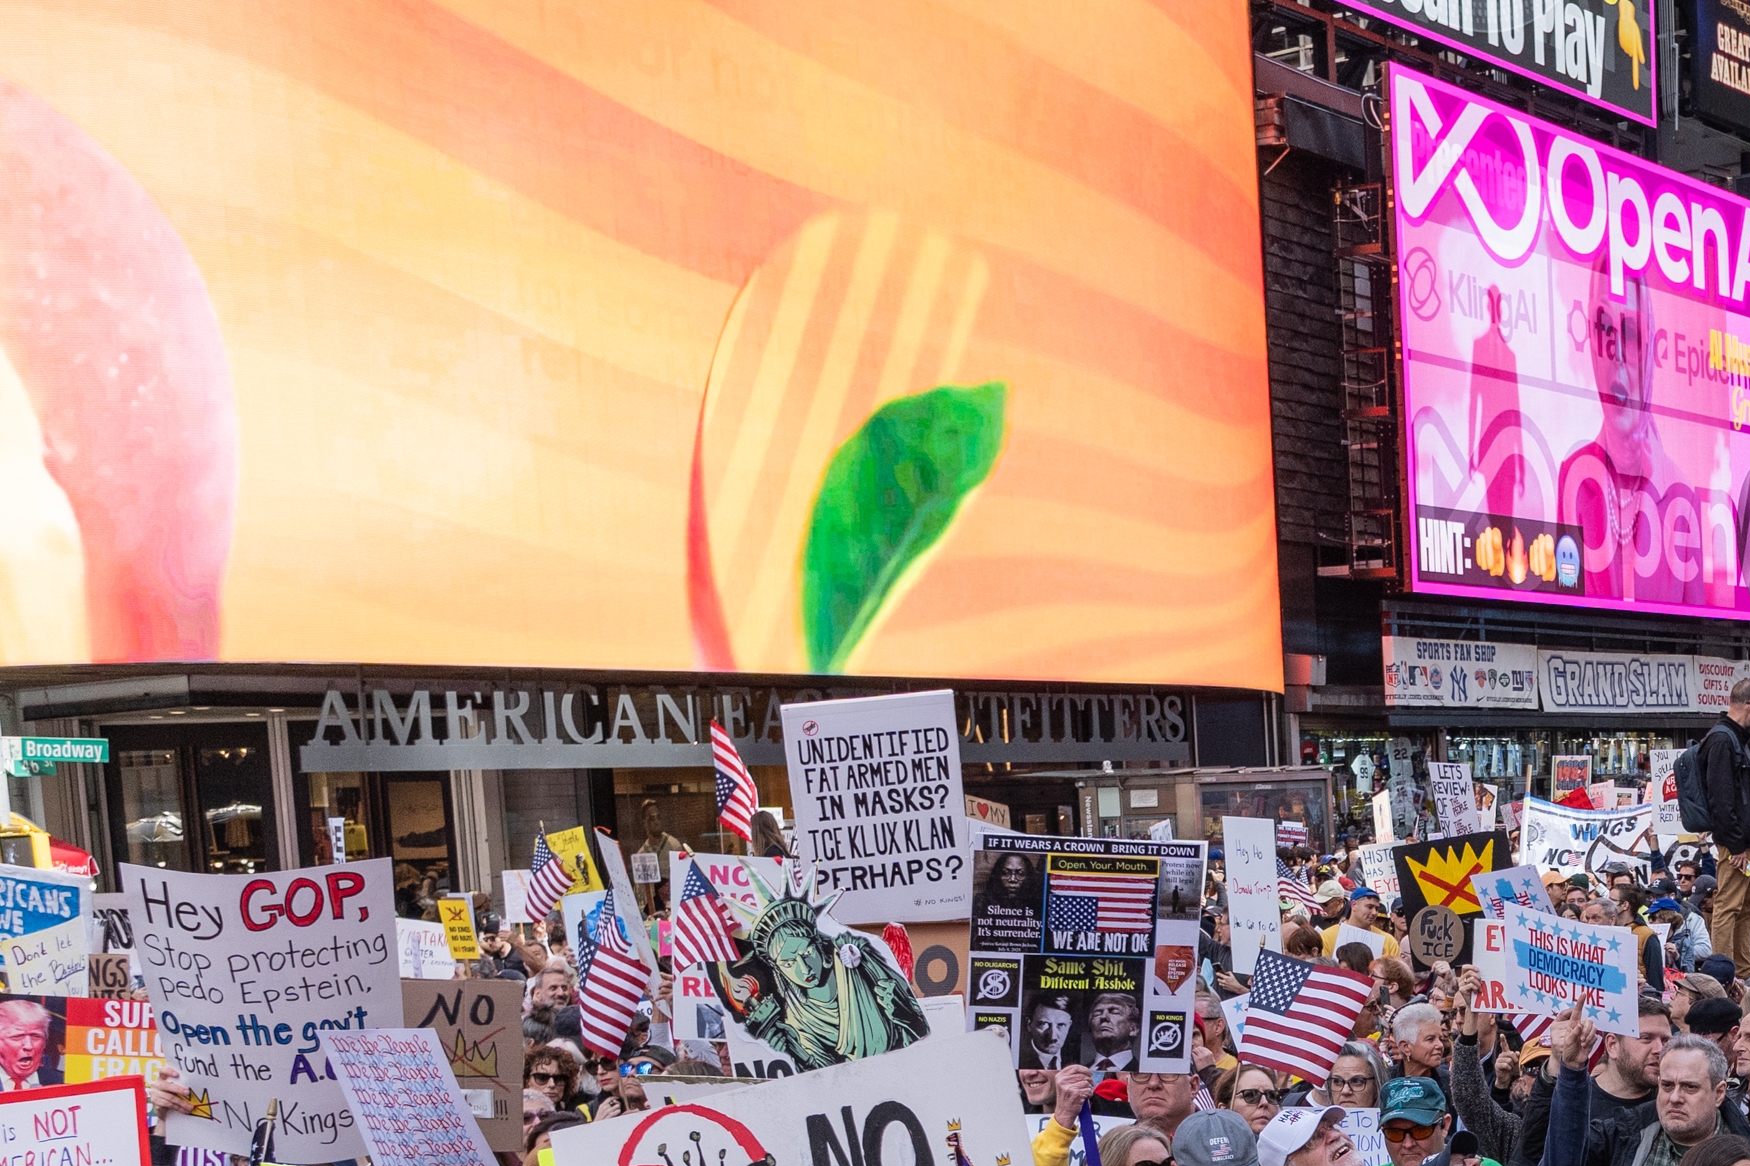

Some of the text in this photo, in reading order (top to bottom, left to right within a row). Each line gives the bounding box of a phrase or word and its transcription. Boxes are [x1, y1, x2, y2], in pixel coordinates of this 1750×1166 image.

[1717, 22, 1750, 62] GREAT
[1419, 518, 1472, 575] HINT:
[1417, 641, 1496, 663] SPORTS FAN SHOP
[306, 689, 696, 746] AMERICAN
[25, 740, 103, 762] Broadway
[798, 727, 949, 765] UNIDENTIFIED
[805, 756, 950, 793] FAT ARMED MEN
[1433, 782, 1470, 797] REVIEW:
[1438, 764, 1462, 780] LETS
[816, 784, 949, 821] IN MASKS?
[808, 816, 956, 863] ICE KLUX KLAN
[988, 838, 1195, 856] IF IT WEARS A CROWN BRING IT DOWN
[1059, 860, 1149, 871] Open. Your. Mouth.
[141, 872, 369, 940] Hey GOP,
[978, 918, 1043, 928] not neutrality.
[987, 905, 1033, 916] Silence is
[978, 928, 1041, 938] It's surrender.
[1053, 931, 1073, 950] WE
[1076, 933, 1101, 951] ARE
[1105, 933, 1129, 952] NOT
[1132, 934, 1150, 952] OK
[1420, 910, 1454, 941] Fuck
[144, 934, 212, 978] Stop
[227, 934, 388, 983] protecting
[1423, 942, 1453, 958] ICE
[1529, 928, 1606, 966] THIS IS WHAT
[1040, 975, 1135, 990] Different Asshole
[1044, 958, 1085, 975] Same
[1529, 949, 1605, 985] DEMOCRACY
[159, 974, 372, 1013] pedo Epstein,
[1528, 969, 1605, 1008] LOOKS LIKE
[417, 988, 494, 1028] NO
[2, 1105, 81, 1143] is NOT
